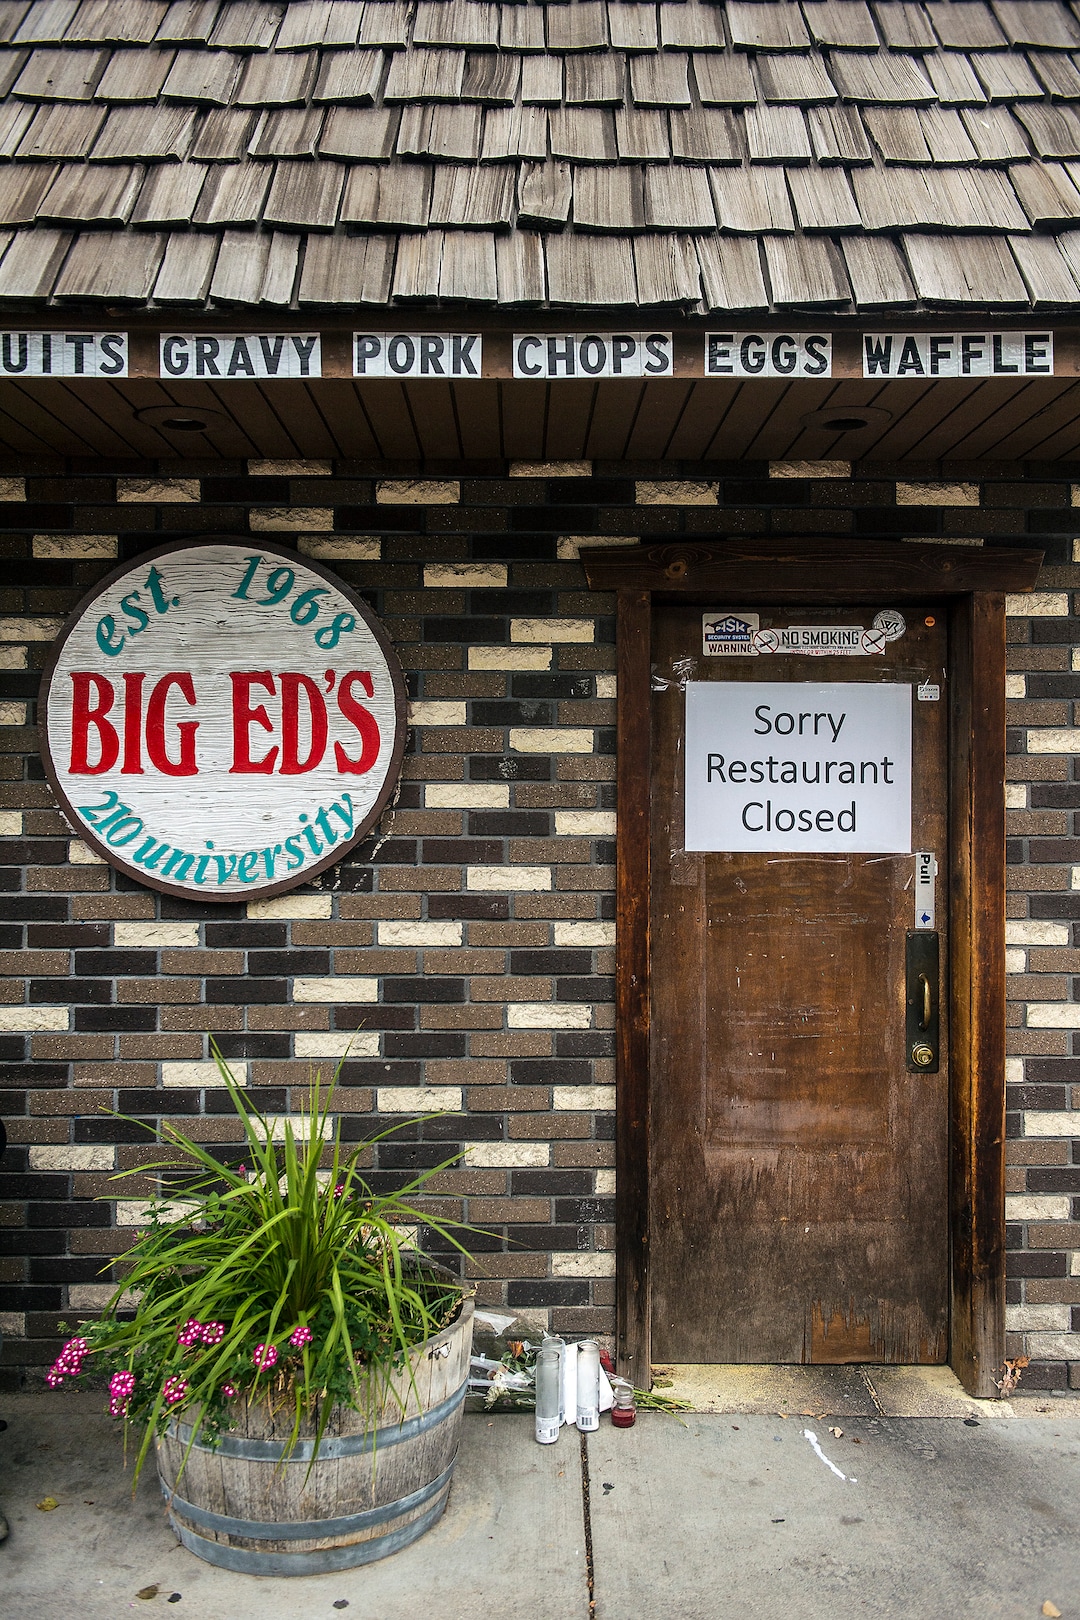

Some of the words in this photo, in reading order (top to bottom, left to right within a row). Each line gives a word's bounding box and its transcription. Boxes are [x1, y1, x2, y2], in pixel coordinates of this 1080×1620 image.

[2, 333, 125, 375] UITS
[163, 334, 319, 376] GRAVY
[357, 334, 479, 375] PORK
[517, 333, 670, 376] CHOPS
[708, 334, 829, 375] EGGS
[865, 333, 1051, 375] WAFFLE
[96, 565, 180, 657] est.
[231, 555, 356, 650] 1968
[708, 643, 752, 653] WARNING
[782, 631, 799, 645] NO
[802, 631, 859, 645] SMOKING
[68, 672, 200, 776] BIG
[228, 669, 381, 776] ED'S
[754, 704, 847, 743] Sorry
[706, 753, 894, 784] Restaurant
[741, 800, 856, 833] Closed
[77, 790, 143, 847] 210
[133, 792, 355, 885] university
[920, 854, 931, 885] Pull
